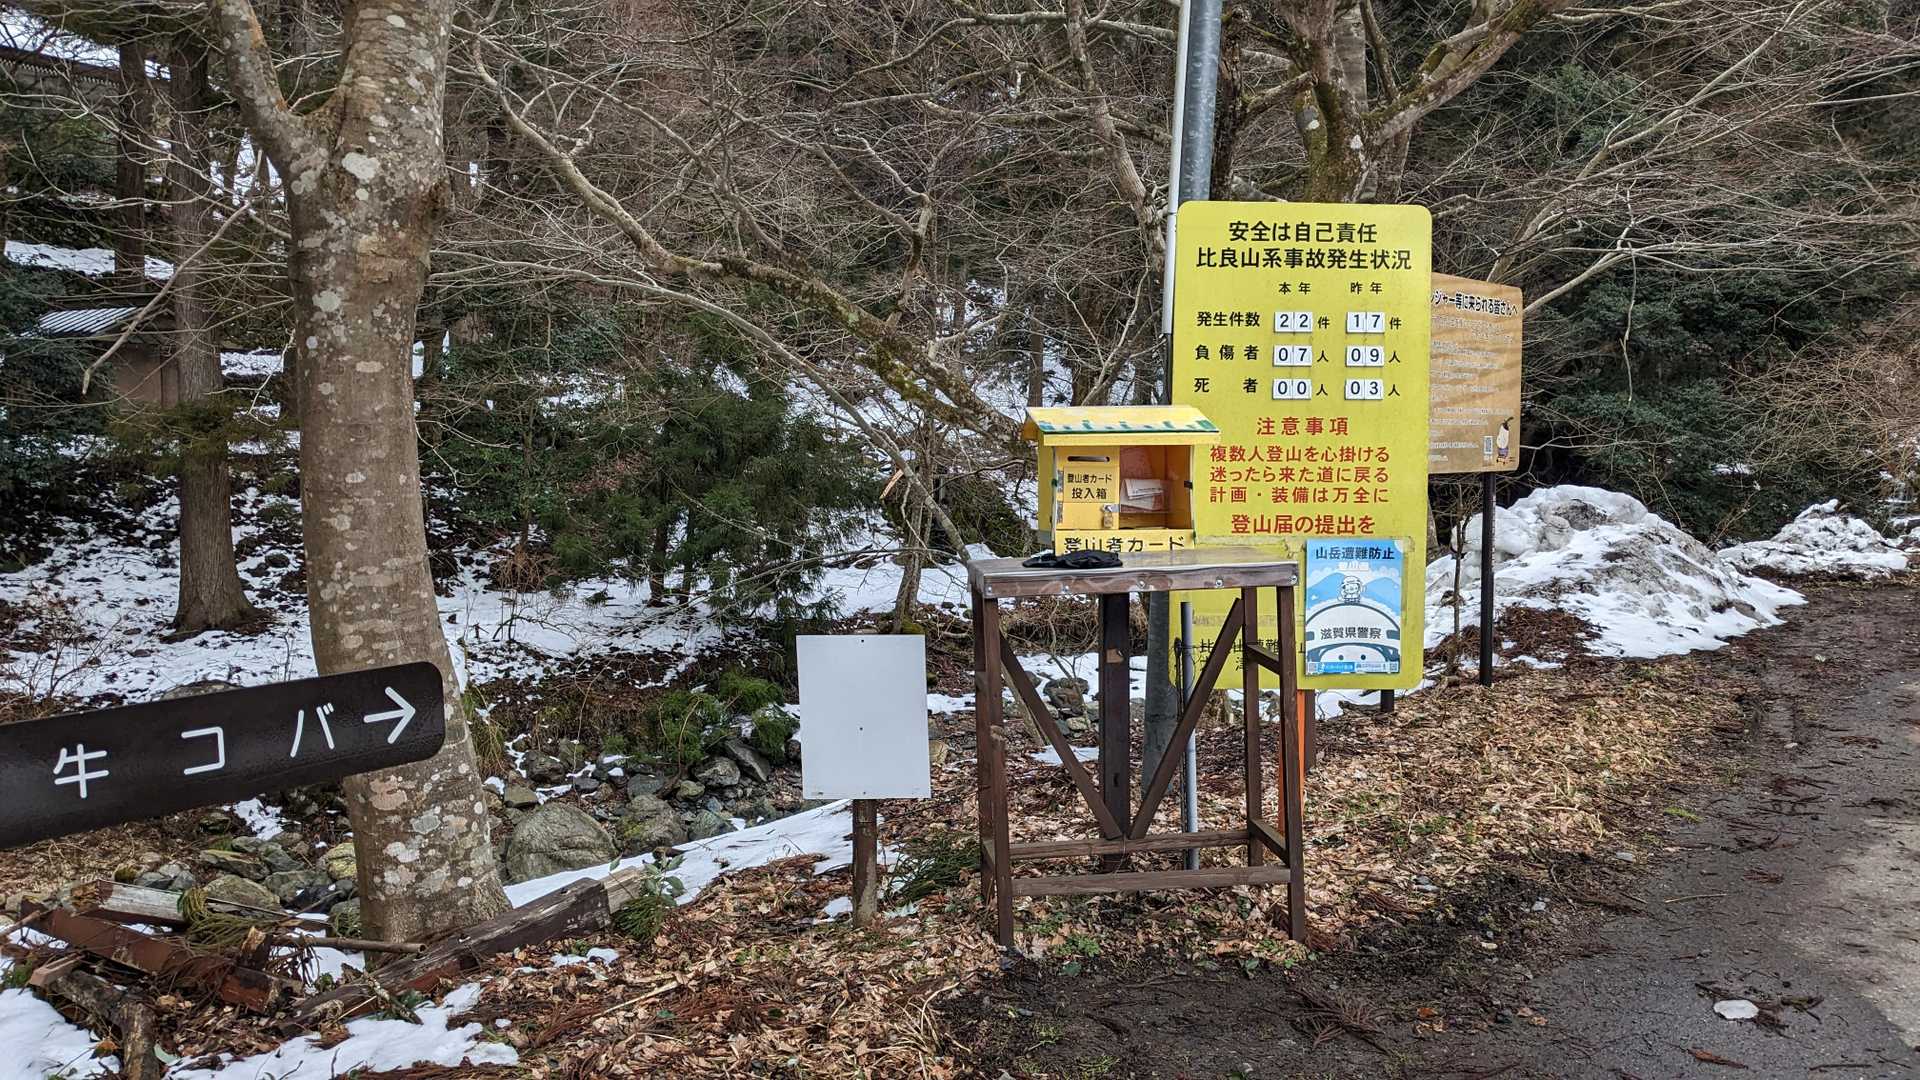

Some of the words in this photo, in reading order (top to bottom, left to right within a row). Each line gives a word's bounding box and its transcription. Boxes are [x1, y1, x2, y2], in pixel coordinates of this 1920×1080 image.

[1229, 221, 1378, 244] 安全は自己責任
[1196, 247, 1412, 270] 比良山系事故発生状況
[1279, 282, 1312, 295] 本年
[1350, 282, 1383, 295] 昨年
[1197, 311, 1260, 328] 発生件数
[1279, 314, 1309, 328] 22
[1317, 316, 1330, 330] 件
[1353, 314, 1381, 328] 17
[1389, 316, 1402, 330] 件
[1195, 344, 1260, 361] 負傷者
[1278, 348, 1308, 362] 07
[1316, 350, 1329, 363] 人
[1351, 348, 1380, 362] 09
[1388, 350, 1401, 363] 人
[1277, 381, 1307, 395] 00
[1316, 384, 1329, 397] 人
[1351, 381, 1379, 395] 03
[1388, 384, 1401, 397] 人
[1256, 417, 1349, 436] 注意事項
[1210, 445, 1390, 462] 複数人登山を心掛ける
[1067, 473, 1112, 484] 登山者カード
[1210, 466, 1390, 483] 迷ったら来た道に戻る
[1071, 487, 1108, 500] 投入箱
[1210, 487, 1389, 504] 計画・装備は万全に
[1231, 514, 1376, 535] 登山届の提出を
[1064, 536, 1184, 553] 登山者カード
[1316, 546, 1395, 560] 山岳遭難防止
[1320, 626, 1382, 640] 滋賀県警察
